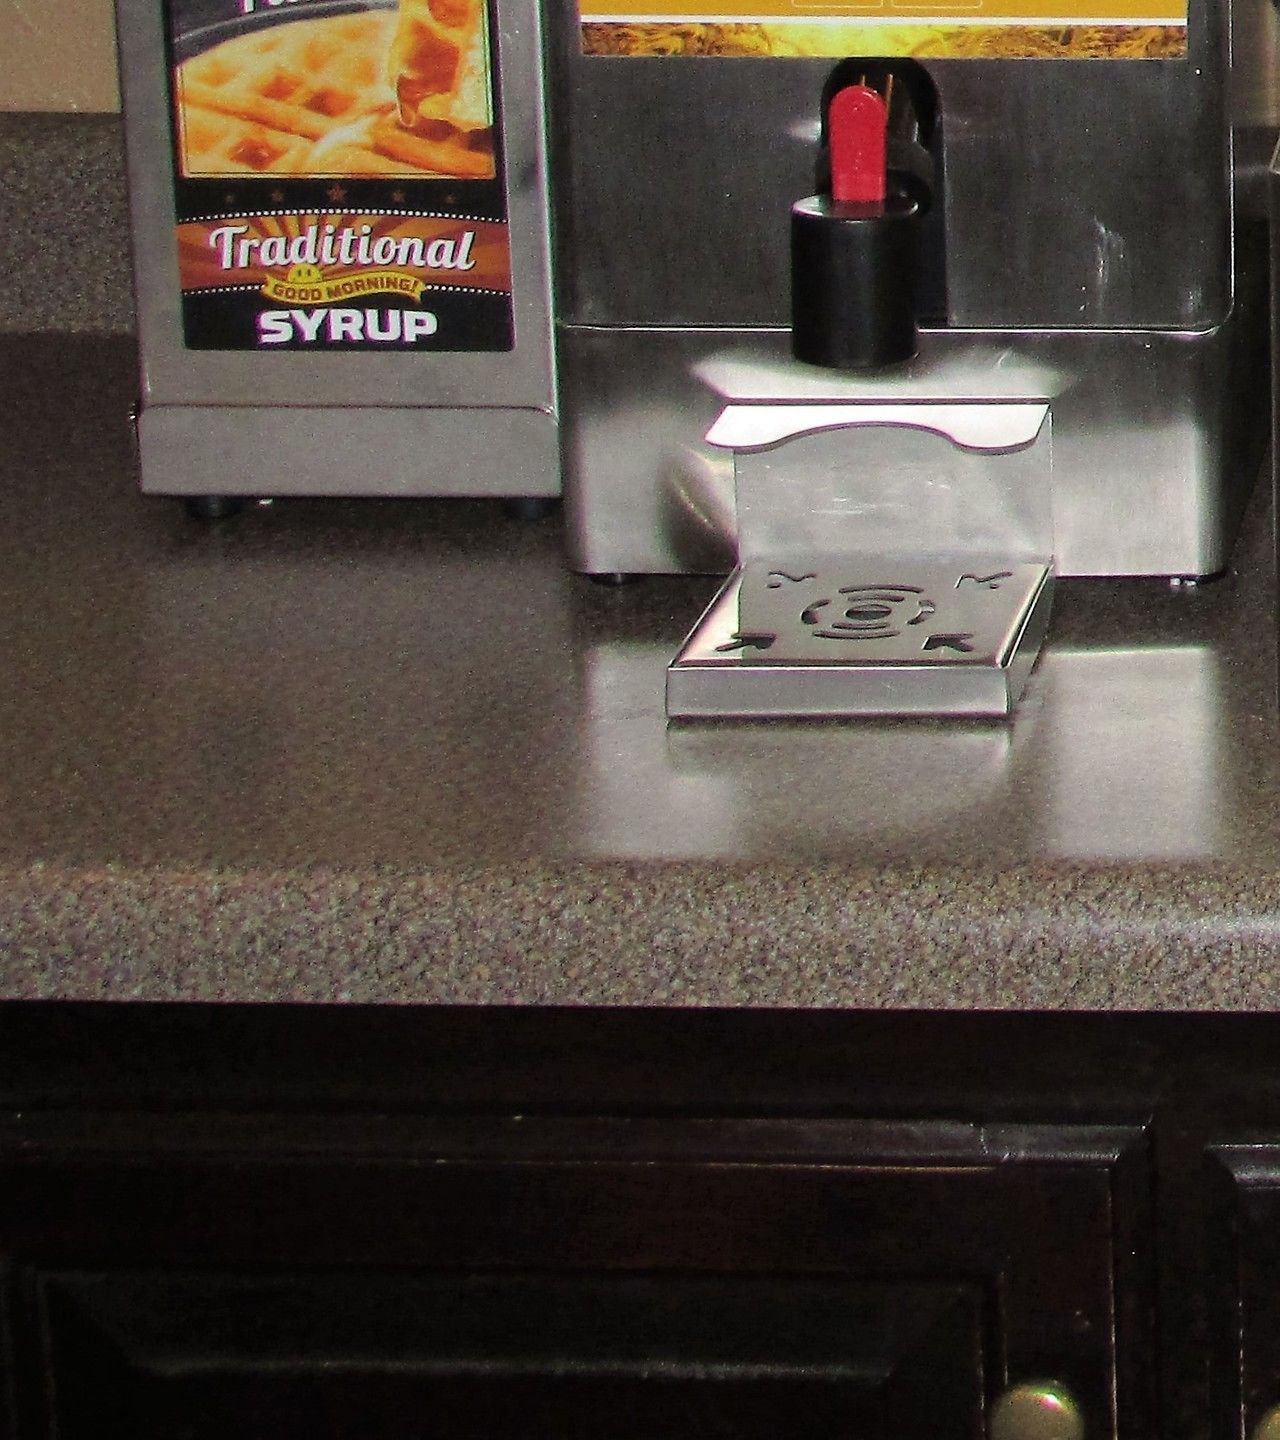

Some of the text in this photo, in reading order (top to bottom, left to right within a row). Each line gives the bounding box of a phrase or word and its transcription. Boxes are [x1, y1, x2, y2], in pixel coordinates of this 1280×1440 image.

[208, 223, 476, 271] Traditional
[273, 276, 420, 301] GOOD MORNING!
[260, 308, 438, 343] SYRUP
